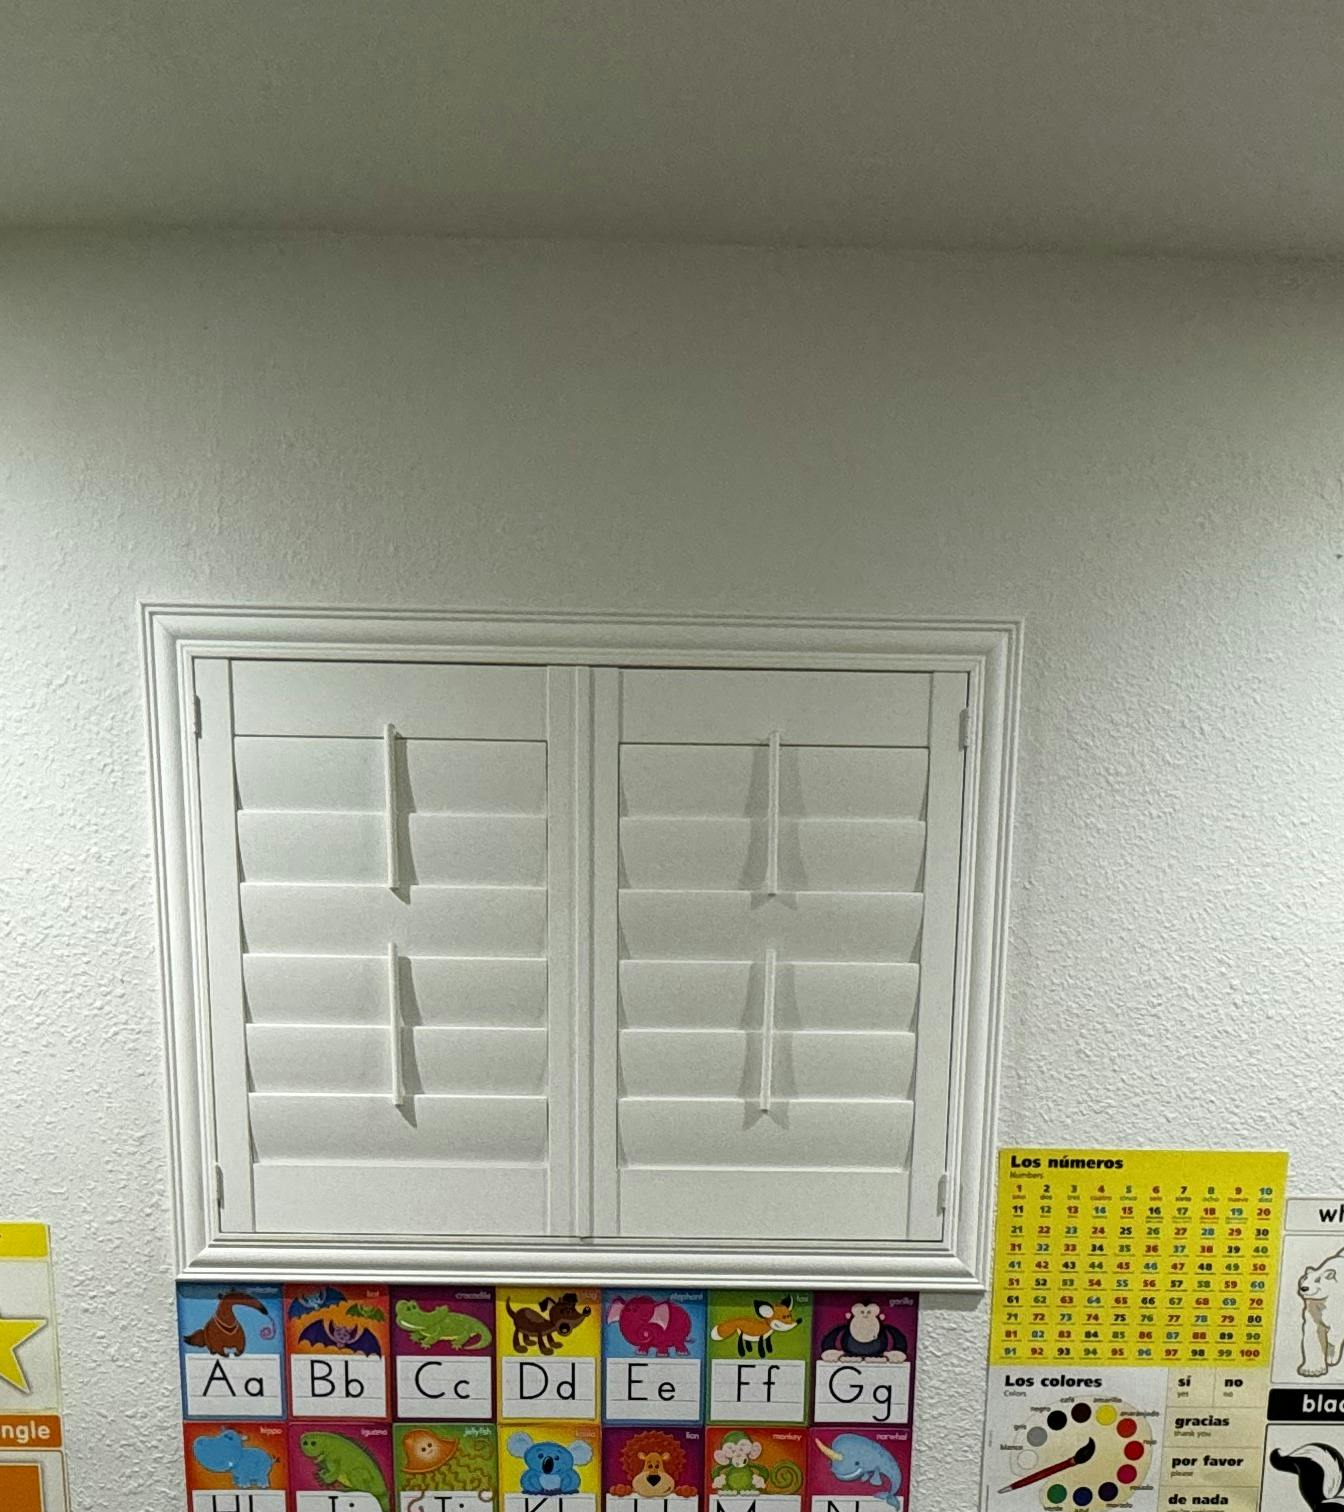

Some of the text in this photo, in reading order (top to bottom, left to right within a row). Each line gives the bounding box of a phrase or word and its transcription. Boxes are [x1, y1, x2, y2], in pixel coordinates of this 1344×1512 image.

[1011, 1155, 1123, 1169] Los números
[1009, 1171, 1043, 1179] Numbers
[1016, 1184, 1022, 1193] 1
[1043, 1184, 1050, 1193] 2
[1098, 1184, 1105, 1194] 4
[1152, 1185, 1161, 1194] 6
[1181, 1185, 1188, 1195] 7
[1259, 1186, 1274, 1196] 10
[1012, 1204, 1024, 1214] 11
[1122, 1205, 1133, 1215] 15
[1176, 1206, 1188, 1216] 17
[1257, 1207, 1271, 1216] 20
[1038, 1225, 1051, 1235] 22
[1120, 1226, 1132, 1236] 25
[1174, 1227, 1187, 1236] 27
[1255, 1228, 1269, 1237] 30
[1091, 1244, 1105, 1253] 34
[1062, 1261, 1077, 1271] 43
[1117, 1262, 1130, 1271] 45
[1198, 1262, 1213, 1272] 48
[1253, 1263, 1266, 1272] 50
[1035, 1278, 1048, 1287] 52
[1088, 1278, 1102, 1288] 54
[1170, 1279, 1183, 1289] 57
[1006, 1295, 1020, 1304] 61
[1169, 1297, 1183, 1306] 67
[1249, 1298, 1263, 1307] 70
[1033, 1312, 1045, 1322] 72
[1113, 1313, 1127, 1323] 75
[1168, 1314, 1181, 1323] 77
[1247, 1314, 1262, 1324] 80
[1084, 1330, 1099, 1340] 84
[1057, 1347, 1071, 1356] 93
[1191, 1348, 1206, 1358] 98
[1240, 1348, 1260, 1358] 100
[1005, 1375, 1102, 1387] Los colores
[1178, 1375, 1191, 1387] sí
[1224, 1379, 1243, 1387] no
[1175, 1415, 1229, 1429] gracias
[772, 1432, 802, 1441] monkey
[1172, 1455, 1244, 1469] por favor
[1168, 1494, 1229, 1504] de nada
